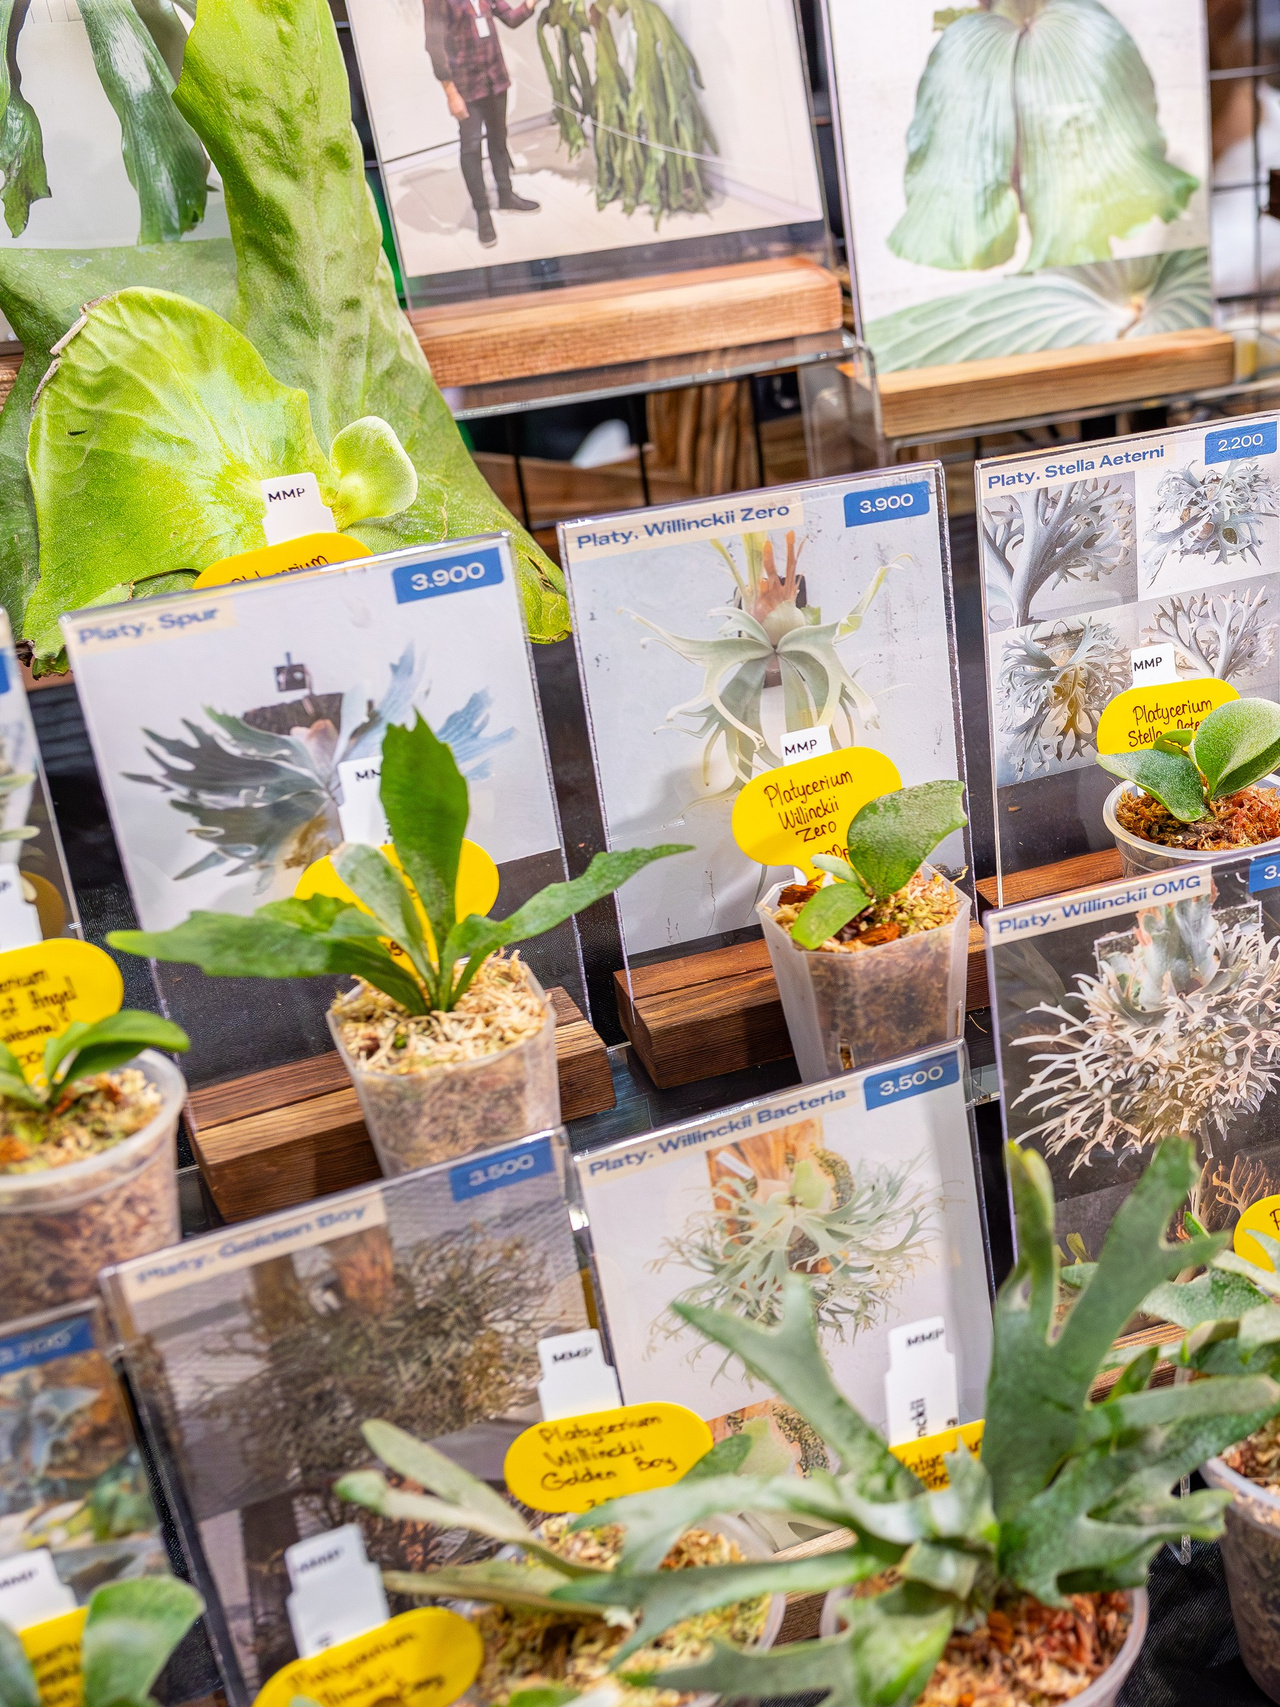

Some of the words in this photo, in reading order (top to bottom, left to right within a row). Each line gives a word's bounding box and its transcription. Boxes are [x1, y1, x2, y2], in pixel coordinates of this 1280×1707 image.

[1218, 433, 1264, 452] 2.200
[988, 470, 1040, 489] Platy.
[1045, 459, 1095, 479] Stella
[1099, 445, 1165, 468] Aeterni
[267, 486, 306, 503] MMP
[859, 493, 914, 515] 3.900
[643, 510, 736, 538] Willinckii
[740, 504, 790, 522] Zero
[410, 561, 486, 592] 3.900
[78, 620, 155, 647] Platy.
[158, 606, 219, 635] Spur
[1133, 657, 1163, 672] MMP
[1133, 700, 1213, 726] Platycerium
[784, 739, 818, 756] MMP
[764, 771, 854, 808] Platycerium
[778, 796, 840, 830] Willinckii
[795, 821, 837, 843] Zero
[999, 911, 1057, 934] Platy.
[1062, 887, 1148, 919] Willinckii
[1152, 875, 1202, 896] OMG
[879, 1066, 944, 1097] 3.500
[589, 1150, 655, 1177] Platy.
[658, 1115, 753, 1155] Willinckii
[757, 1087, 848, 1124] Bacteria
[469, 1154, 535, 1187] 3.500
[137, 1254, 214, 1285] Platy.
[219, 1219, 314, 1259] Golden
[317, 1204, 369, 1230] Boy
[907, 1328, 944, 1347] MMP
[552, 1346, 592, 1364] MMP
[538, 1415, 662, 1445] Platycerium
[543, 1439, 645, 1467] Willinckii
[540, 1467, 617, 1492] Golden
[633, 1455, 678, 1472] Boy
